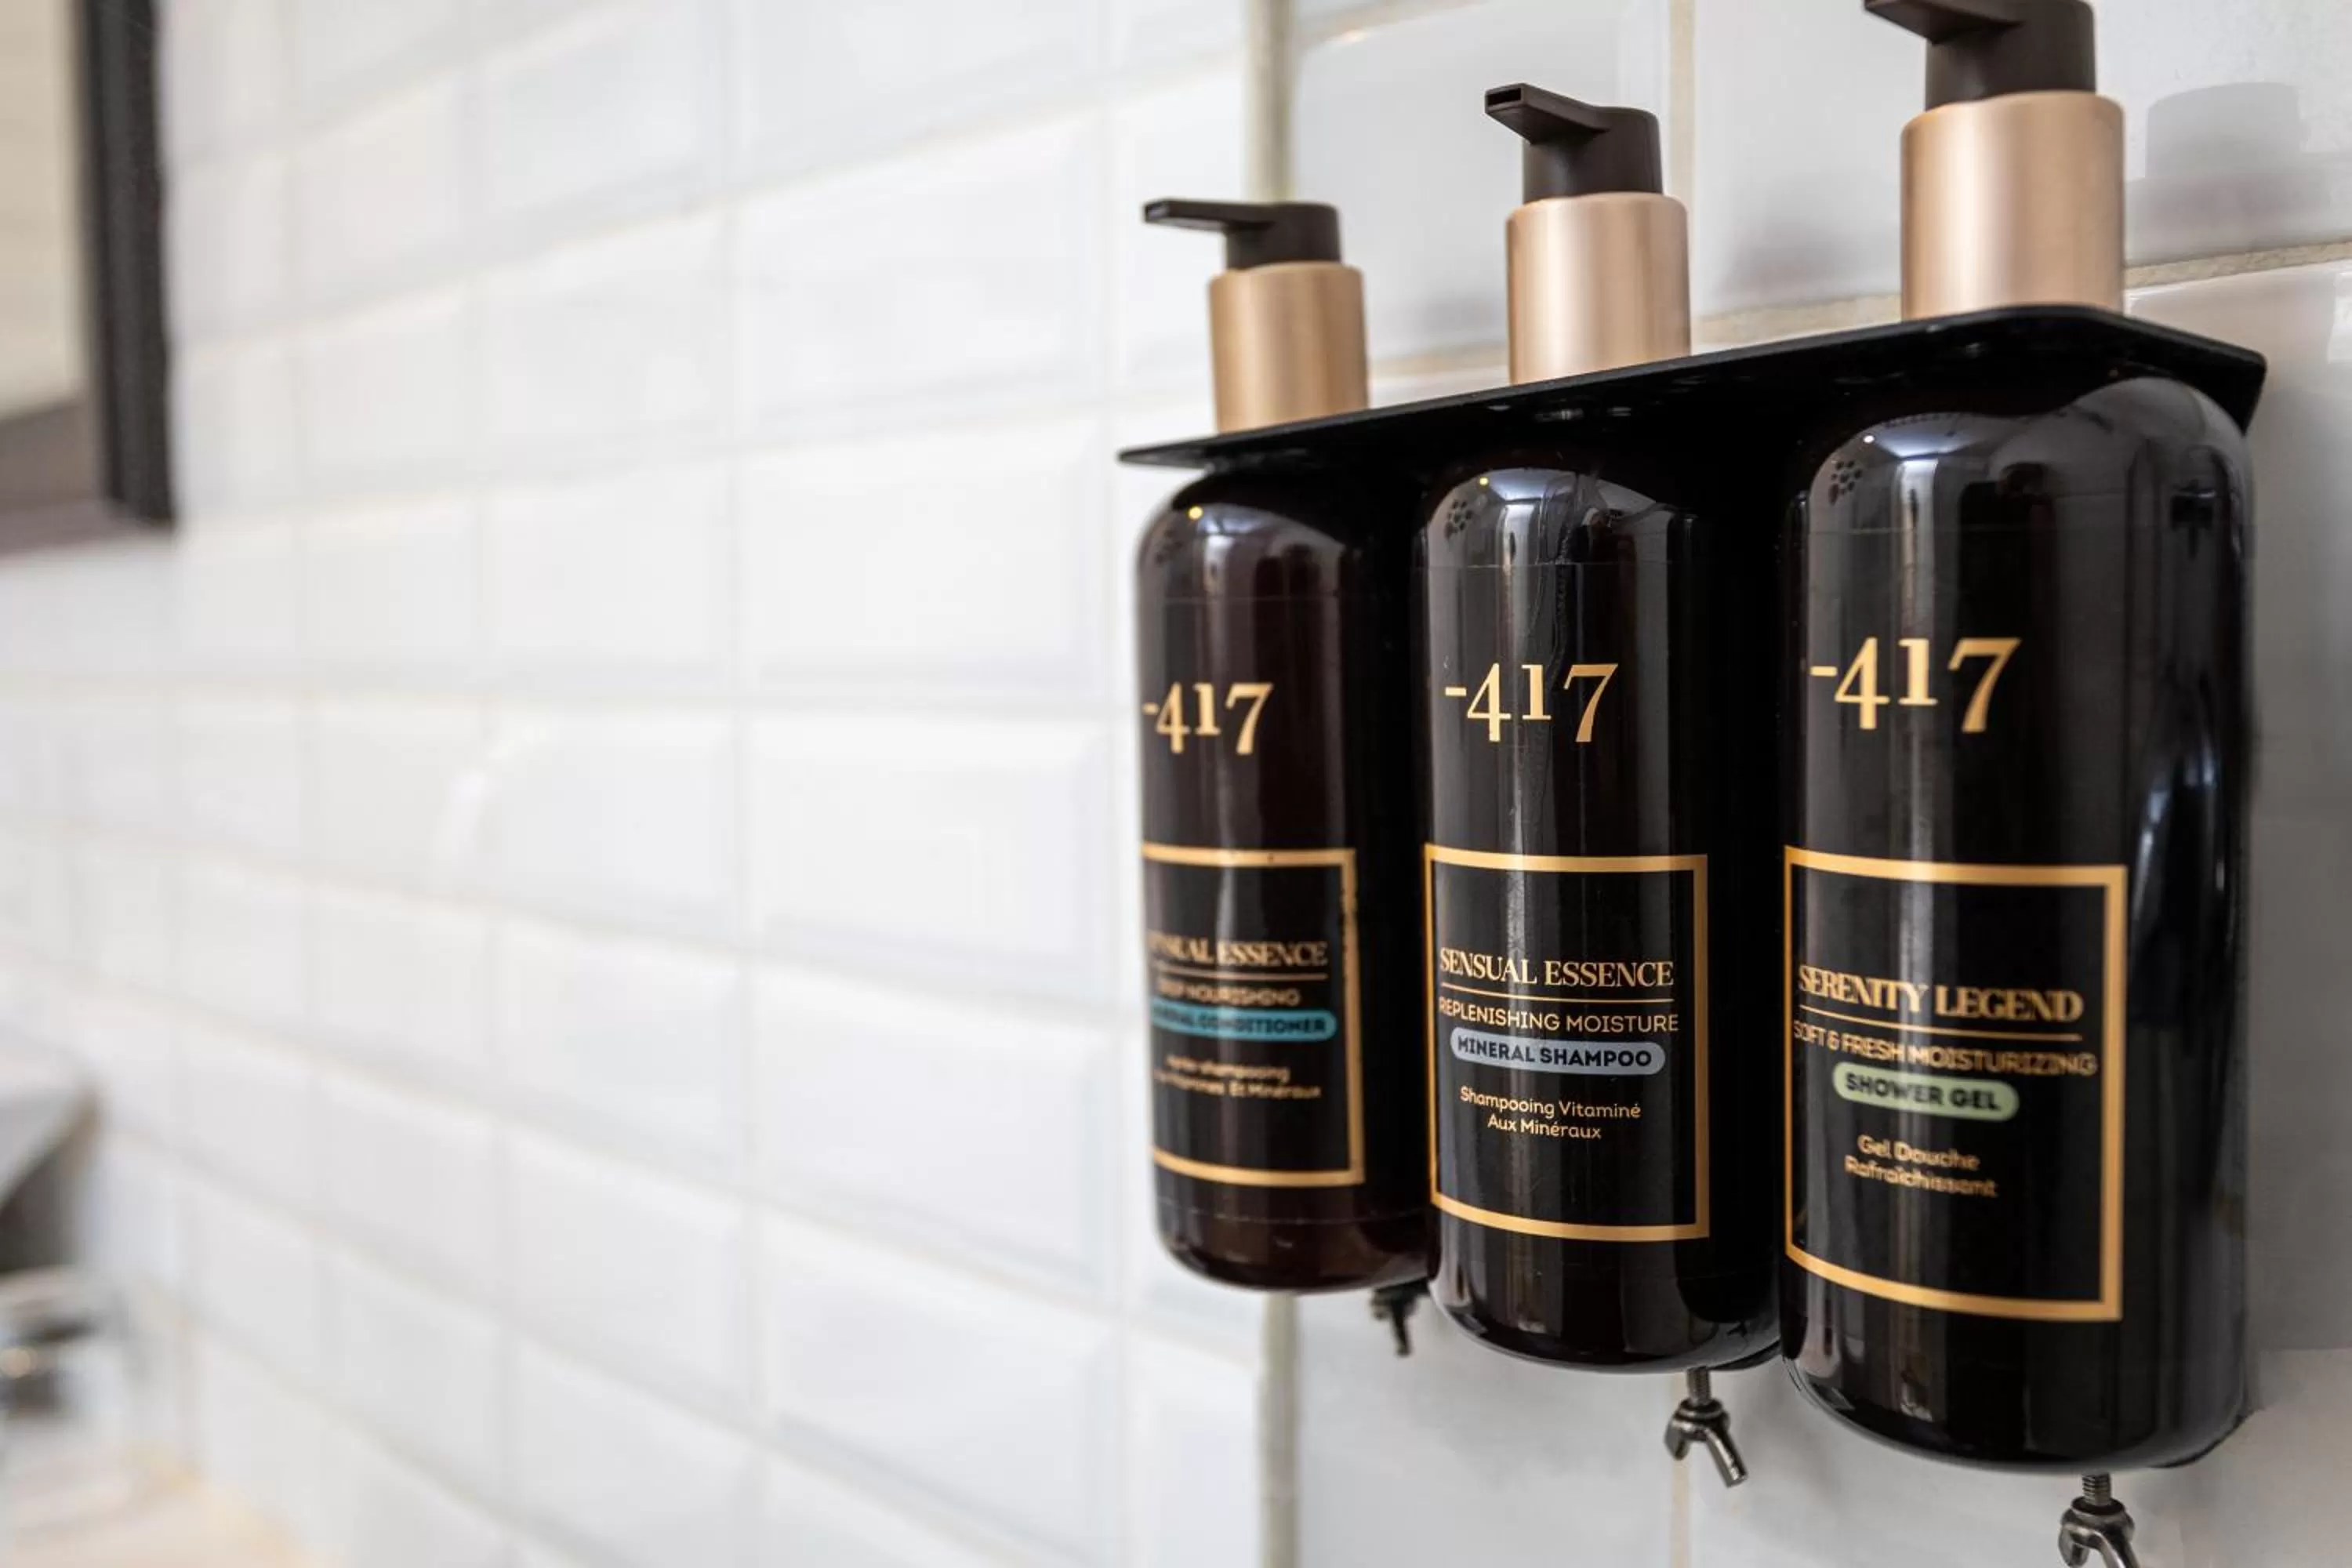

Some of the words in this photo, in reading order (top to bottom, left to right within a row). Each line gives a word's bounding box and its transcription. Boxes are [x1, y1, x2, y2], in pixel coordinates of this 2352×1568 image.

[1445, 662, 1618, 742] -417
[1809, 637, 2022, 733] -417
[1142, 681, 1274, 754] -417
[1217, 941, 1328, 967] ESSENCE
[1440, 946, 1537, 984] SENSUAL
[1544, 960, 1674, 988] ESSENCE
[1798, 964, 1928, 1013] SERENITY
[1935, 985, 2085, 1021] LEGEND
[1439, 996, 1560, 1032] REPLENISHING
[1566, 1014, 1679, 1033] MOISTURE
[1457, 1036, 1535, 1063] MINERAL
[1540, 1048, 1653, 1067] SHAMPOO
[1793, 1021, 1825, 1048] SOFT
[1827, 1031, 1840, 1051] &
[1842, 1033, 1905, 1063] FRESH
[1907, 1044, 2099, 1076] MOISTURIZING
[1460, 1085, 1555, 1116] Shampooing
[1559, 1102, 1642, 1120] Vitaminé
[1846, 1073, 1944, 1106] SHOWER
[1950, 1088, 2001, 1112] GEL
[1487, 1114, 1517, 1132] Aux
[1520, 1121, 1602, 1139] Minéraux
[1857, 1134, 1891, 1159] Gel
[1894, 1141, 1980, 1171] Douche
